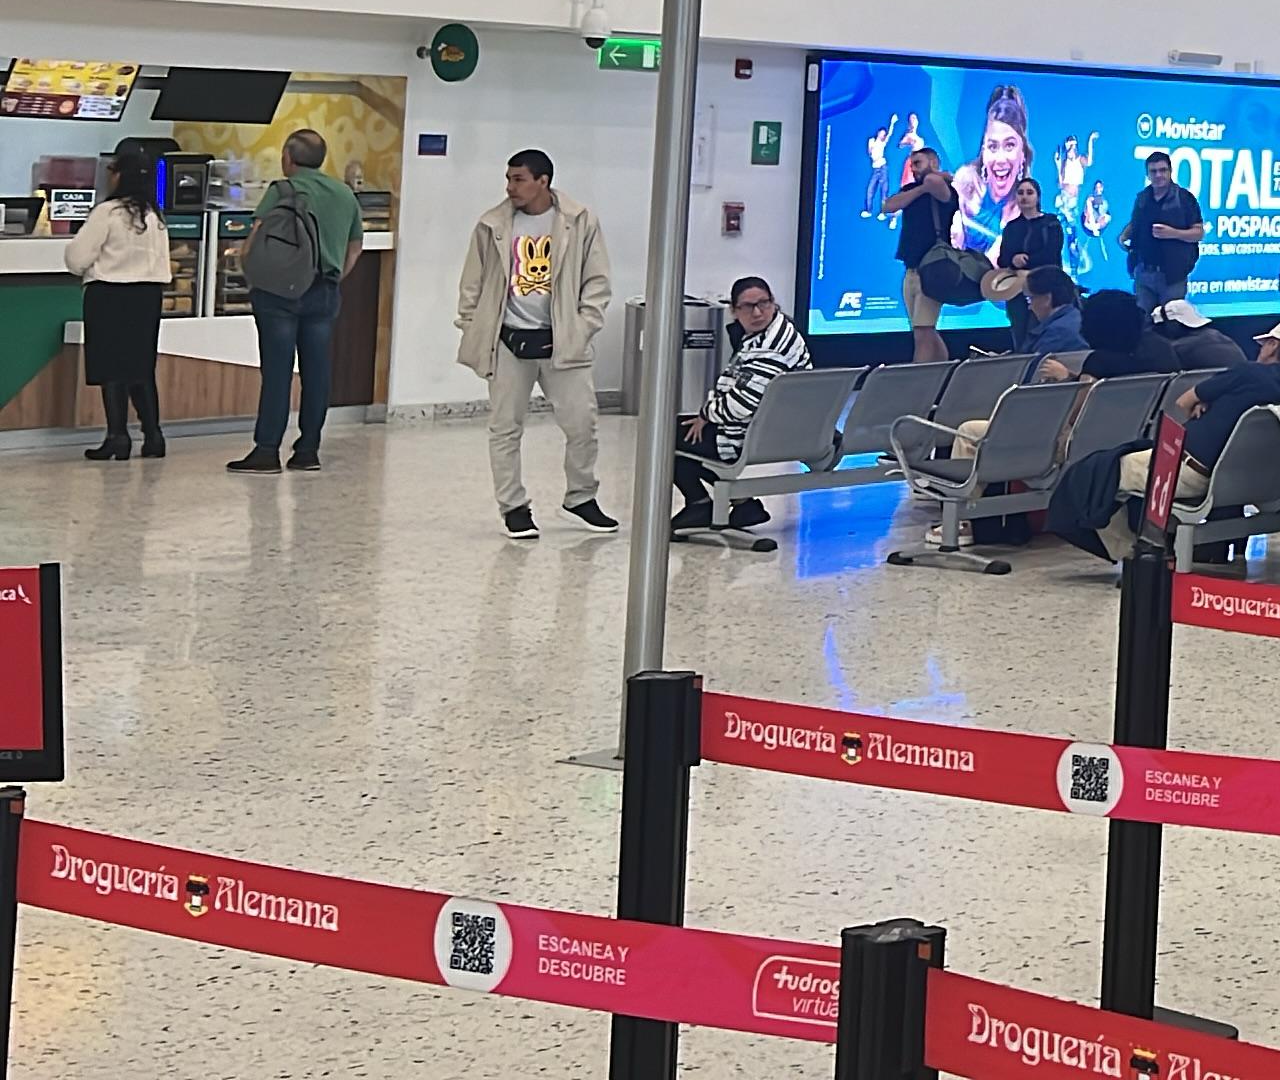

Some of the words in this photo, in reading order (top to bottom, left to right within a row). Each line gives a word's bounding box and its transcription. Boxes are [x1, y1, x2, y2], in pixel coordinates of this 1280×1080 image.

[1156, 117, 1225, 141] Movistar
[724, 711, 837, 753] Droguería
[866, 732, 975, 772] Alemana
[1145, 770, 1210, 789] ESCANEA
[1212, 776, 1222, 789] Y
[1145, 788, 1221, 808] DESCUBRE
[50, 844, 179, 901] Droguería
[214, 876, 340, 932] Alemana
[538, 934, 615, 961] ESCANEA
[617, 946, 629, 963] Y
[538, 957, 626, 986] DESCUBRE
[792, 995, 839, 1018] virtua
[967, 1003, 1122, 1078] Droguería
